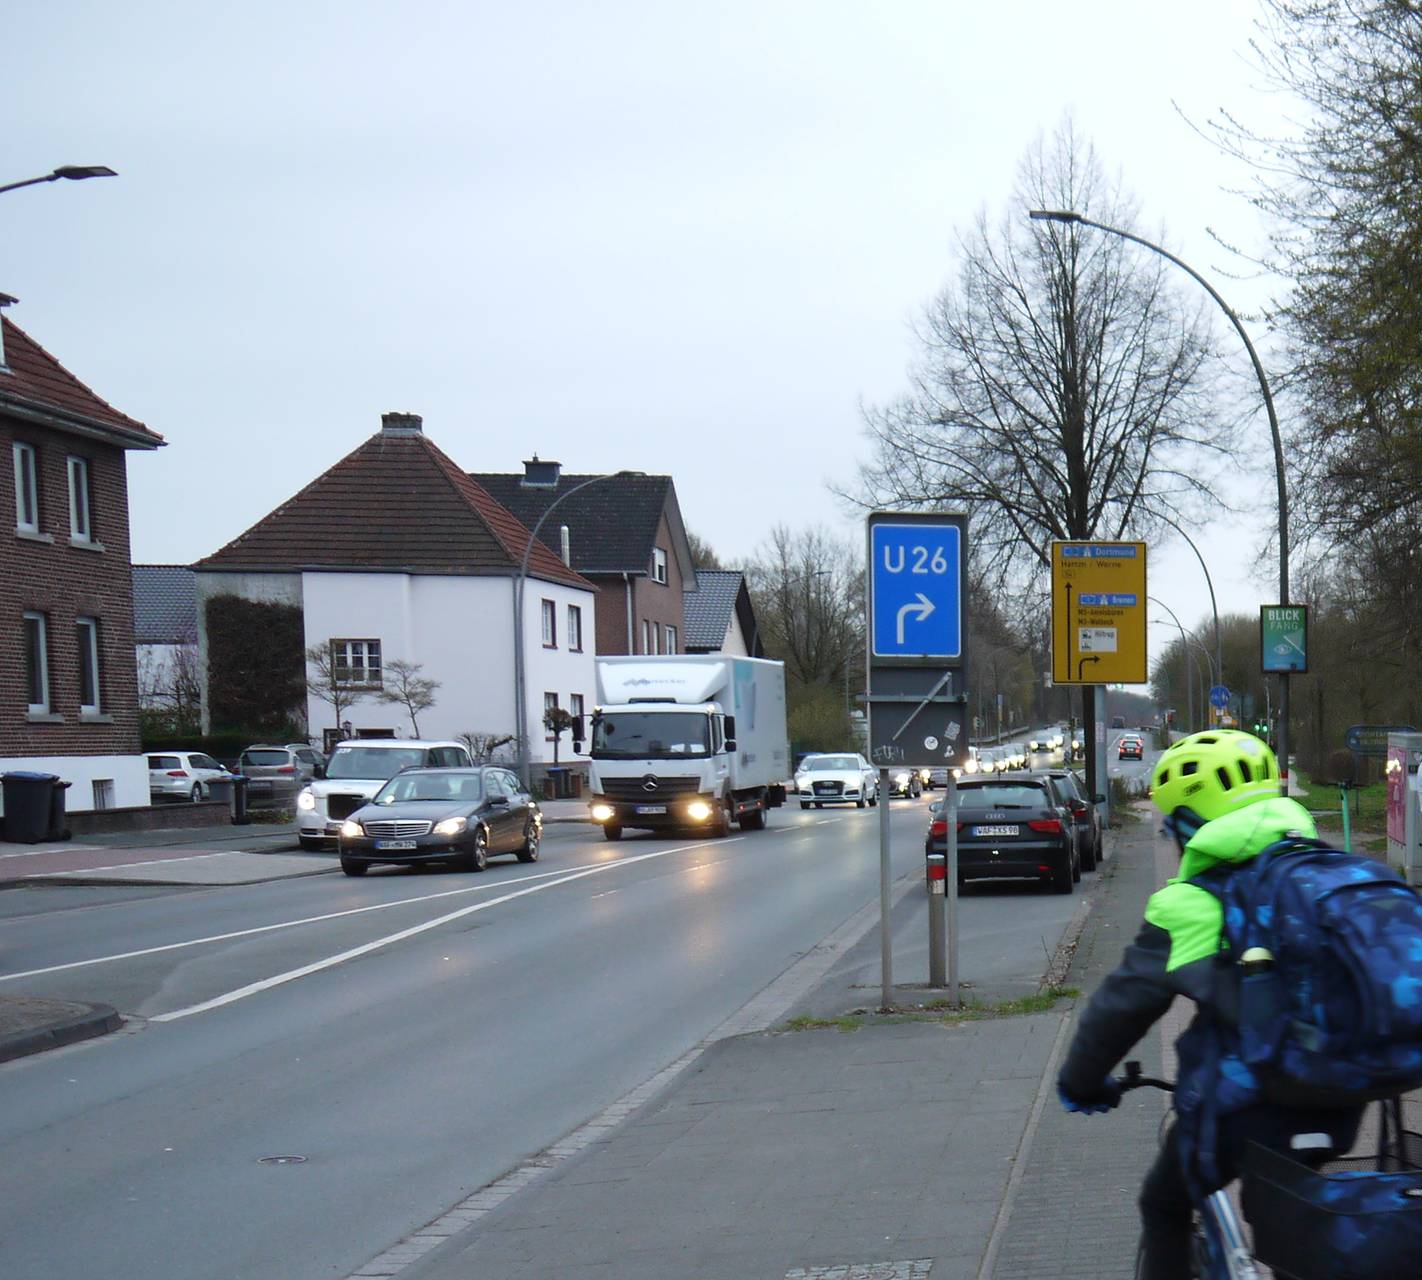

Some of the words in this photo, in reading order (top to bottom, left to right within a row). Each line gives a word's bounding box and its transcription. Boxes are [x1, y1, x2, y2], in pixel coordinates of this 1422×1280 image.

[1095, 547, 1135, 557] Dortmund
[884, 545, 905, 573] U
[912, 546, 947, 574] 26
[1096, 560, 1122, 568] Werne
[1268, 609, 1300, 620] BLICK
[1270, 621, 1299, 631] FANG
